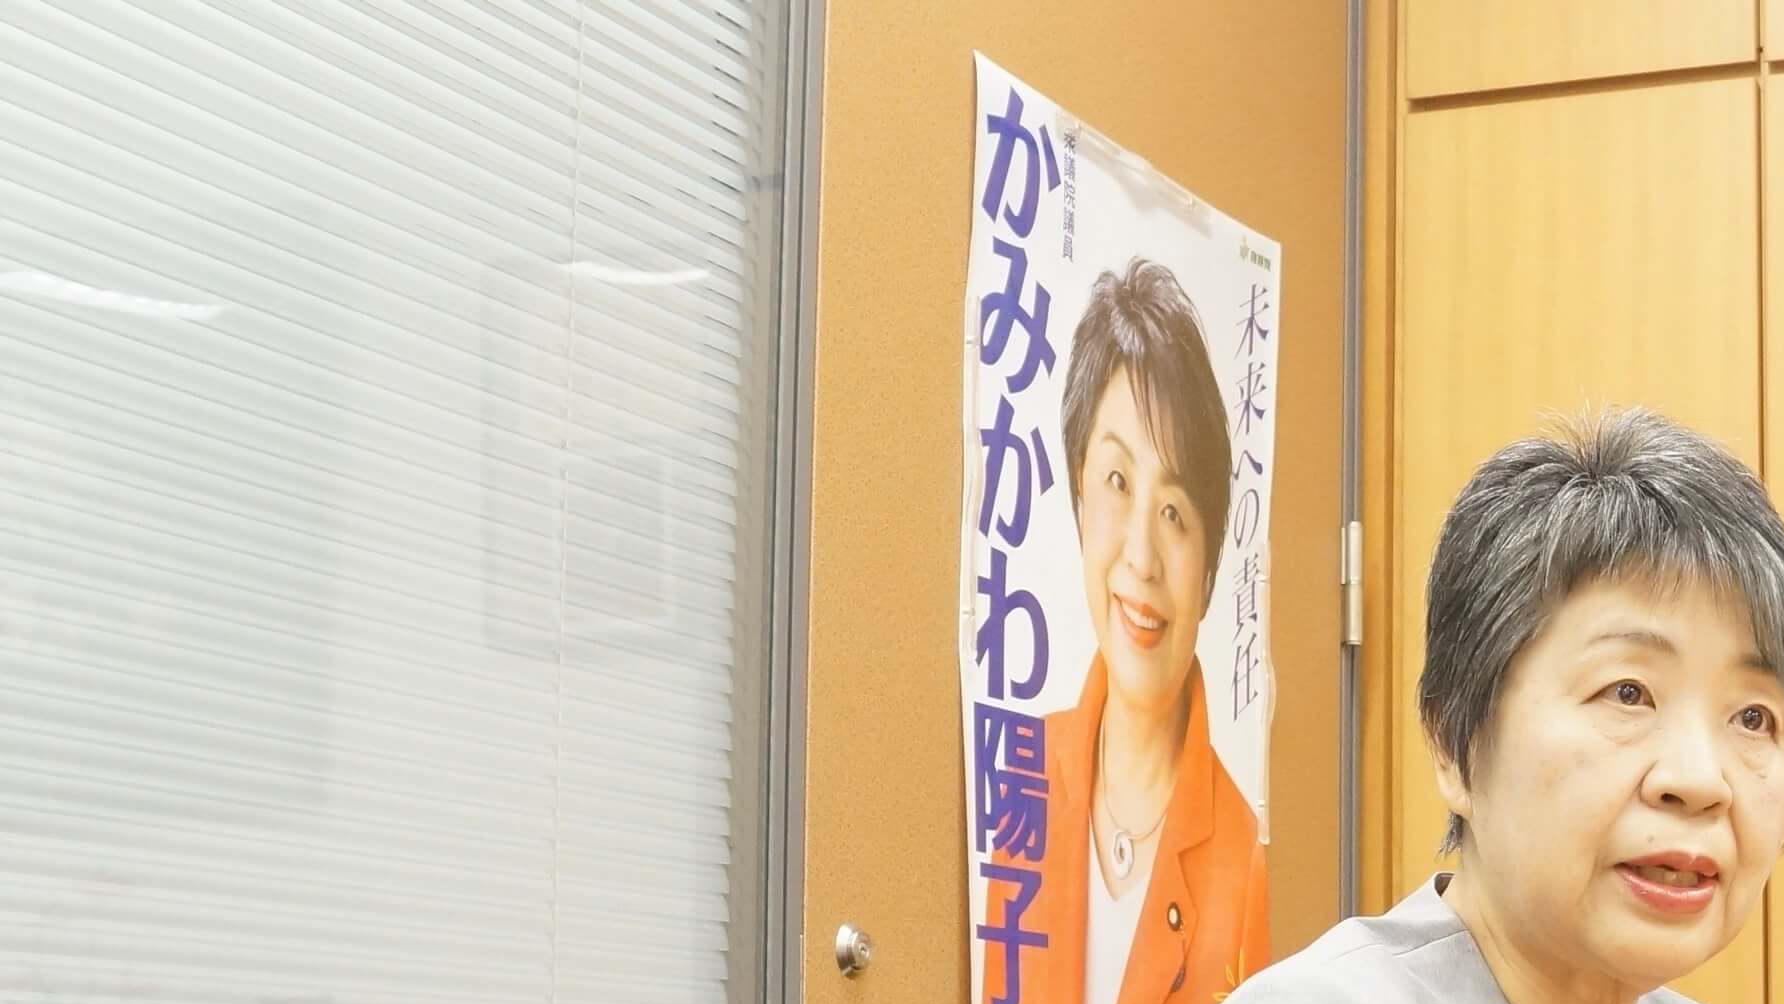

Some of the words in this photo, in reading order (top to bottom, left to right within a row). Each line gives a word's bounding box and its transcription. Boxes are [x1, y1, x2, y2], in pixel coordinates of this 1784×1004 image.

[1063, 130, 1077, 263] 衆議院議員
[1231, 282, 1271, 723] 未来への責任
